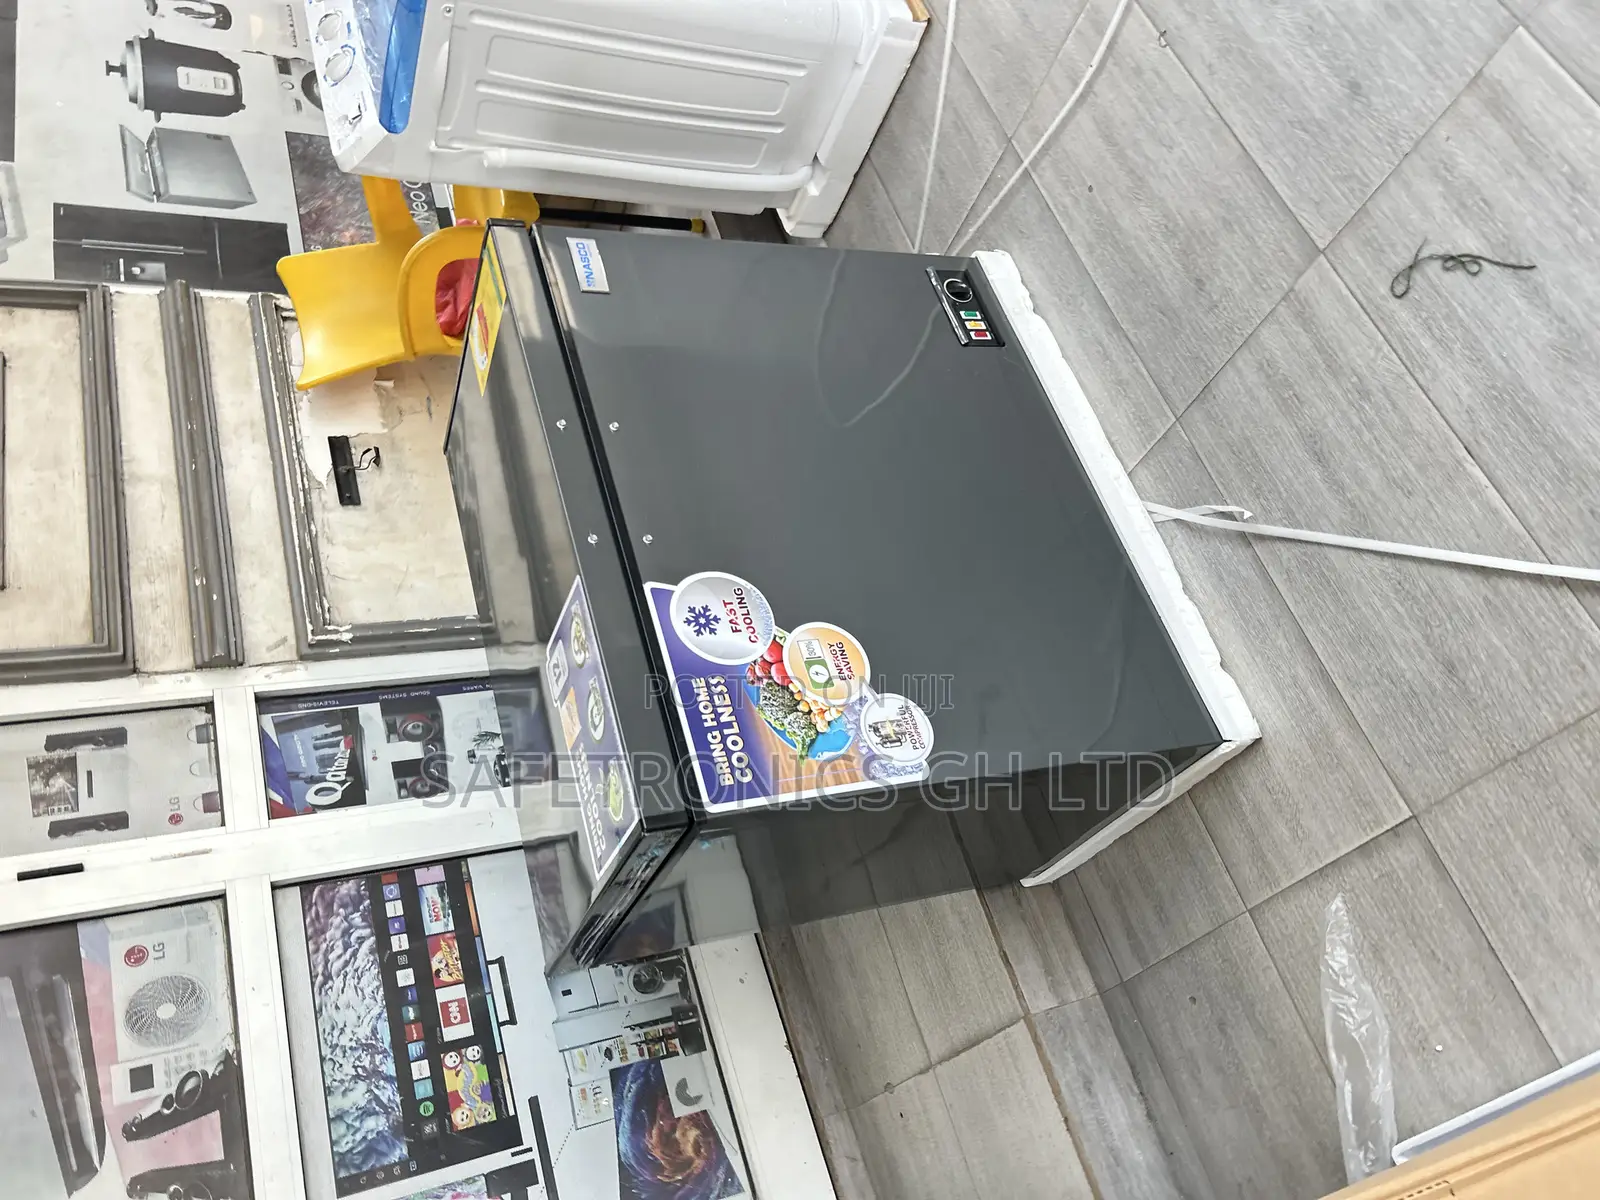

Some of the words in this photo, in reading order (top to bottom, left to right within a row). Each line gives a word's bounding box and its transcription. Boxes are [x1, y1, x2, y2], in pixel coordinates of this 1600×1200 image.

[409, 191, 431, 224] Neo
[576, 242, 594, 280] NASCO
[722, 599, 742, 634] FAST
[734, 587, 758, 643] COOLING
[827, 643, 846, 681] ENERGY
[836, 641, 855, 680] SAVING
[692, 677, 718, 728] HOME
[707, 675, 753, 783] COOLNESS
[898, 704, 920, 750] POWERFUL
[707, 730, 734, 786] BRING
[169, 796, 181, 811] LG
[153, 941, 165, 960] LG
